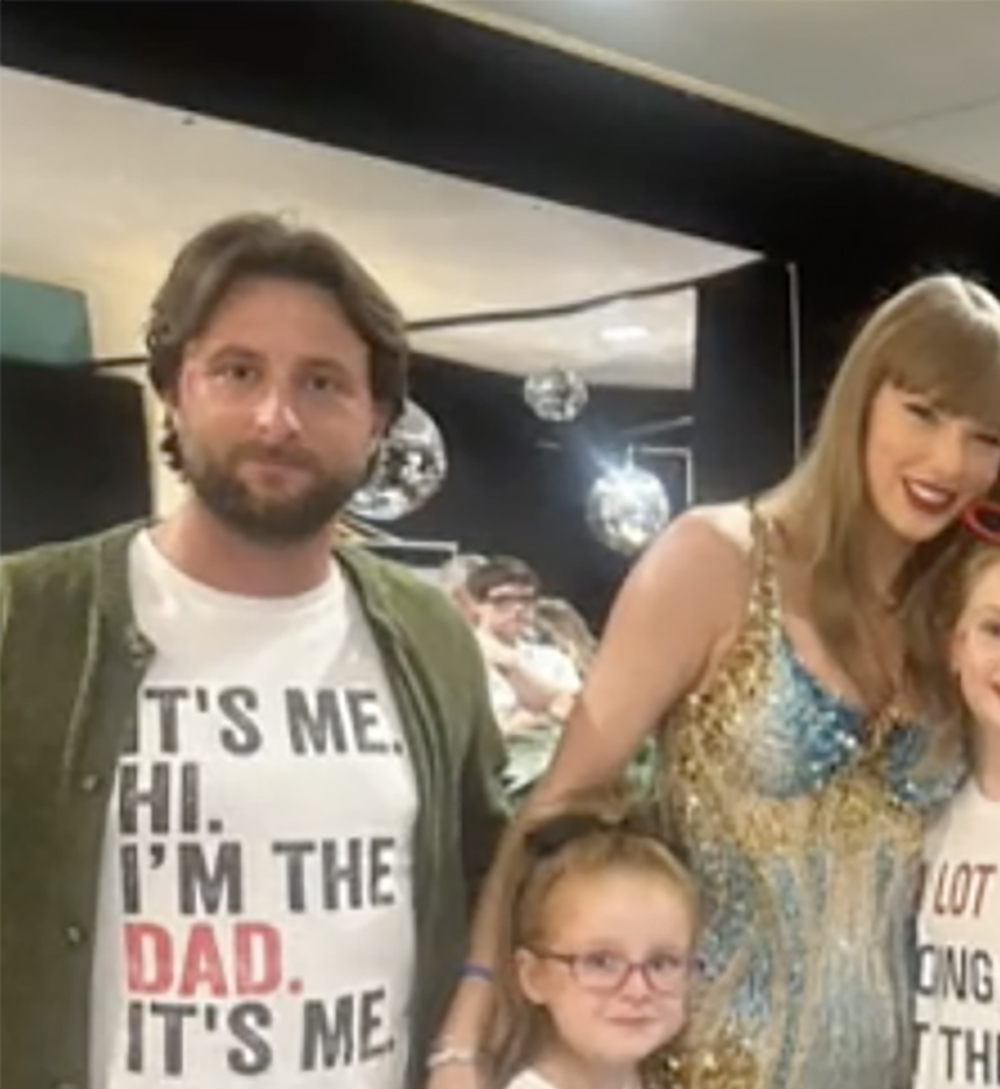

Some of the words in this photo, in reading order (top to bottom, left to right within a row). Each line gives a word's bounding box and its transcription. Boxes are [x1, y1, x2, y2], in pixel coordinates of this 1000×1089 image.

[284, 686, 403, 756] ME.
[119, 762, 224, 835] HI.
[119, 840, 243, 915] I'M
[272, 837, 395, 914] THE
[933, 860, 998, 918] LOT
[123, 921, 304, 998] DAD.
[127, 1000, 274, 1077] IT'S
